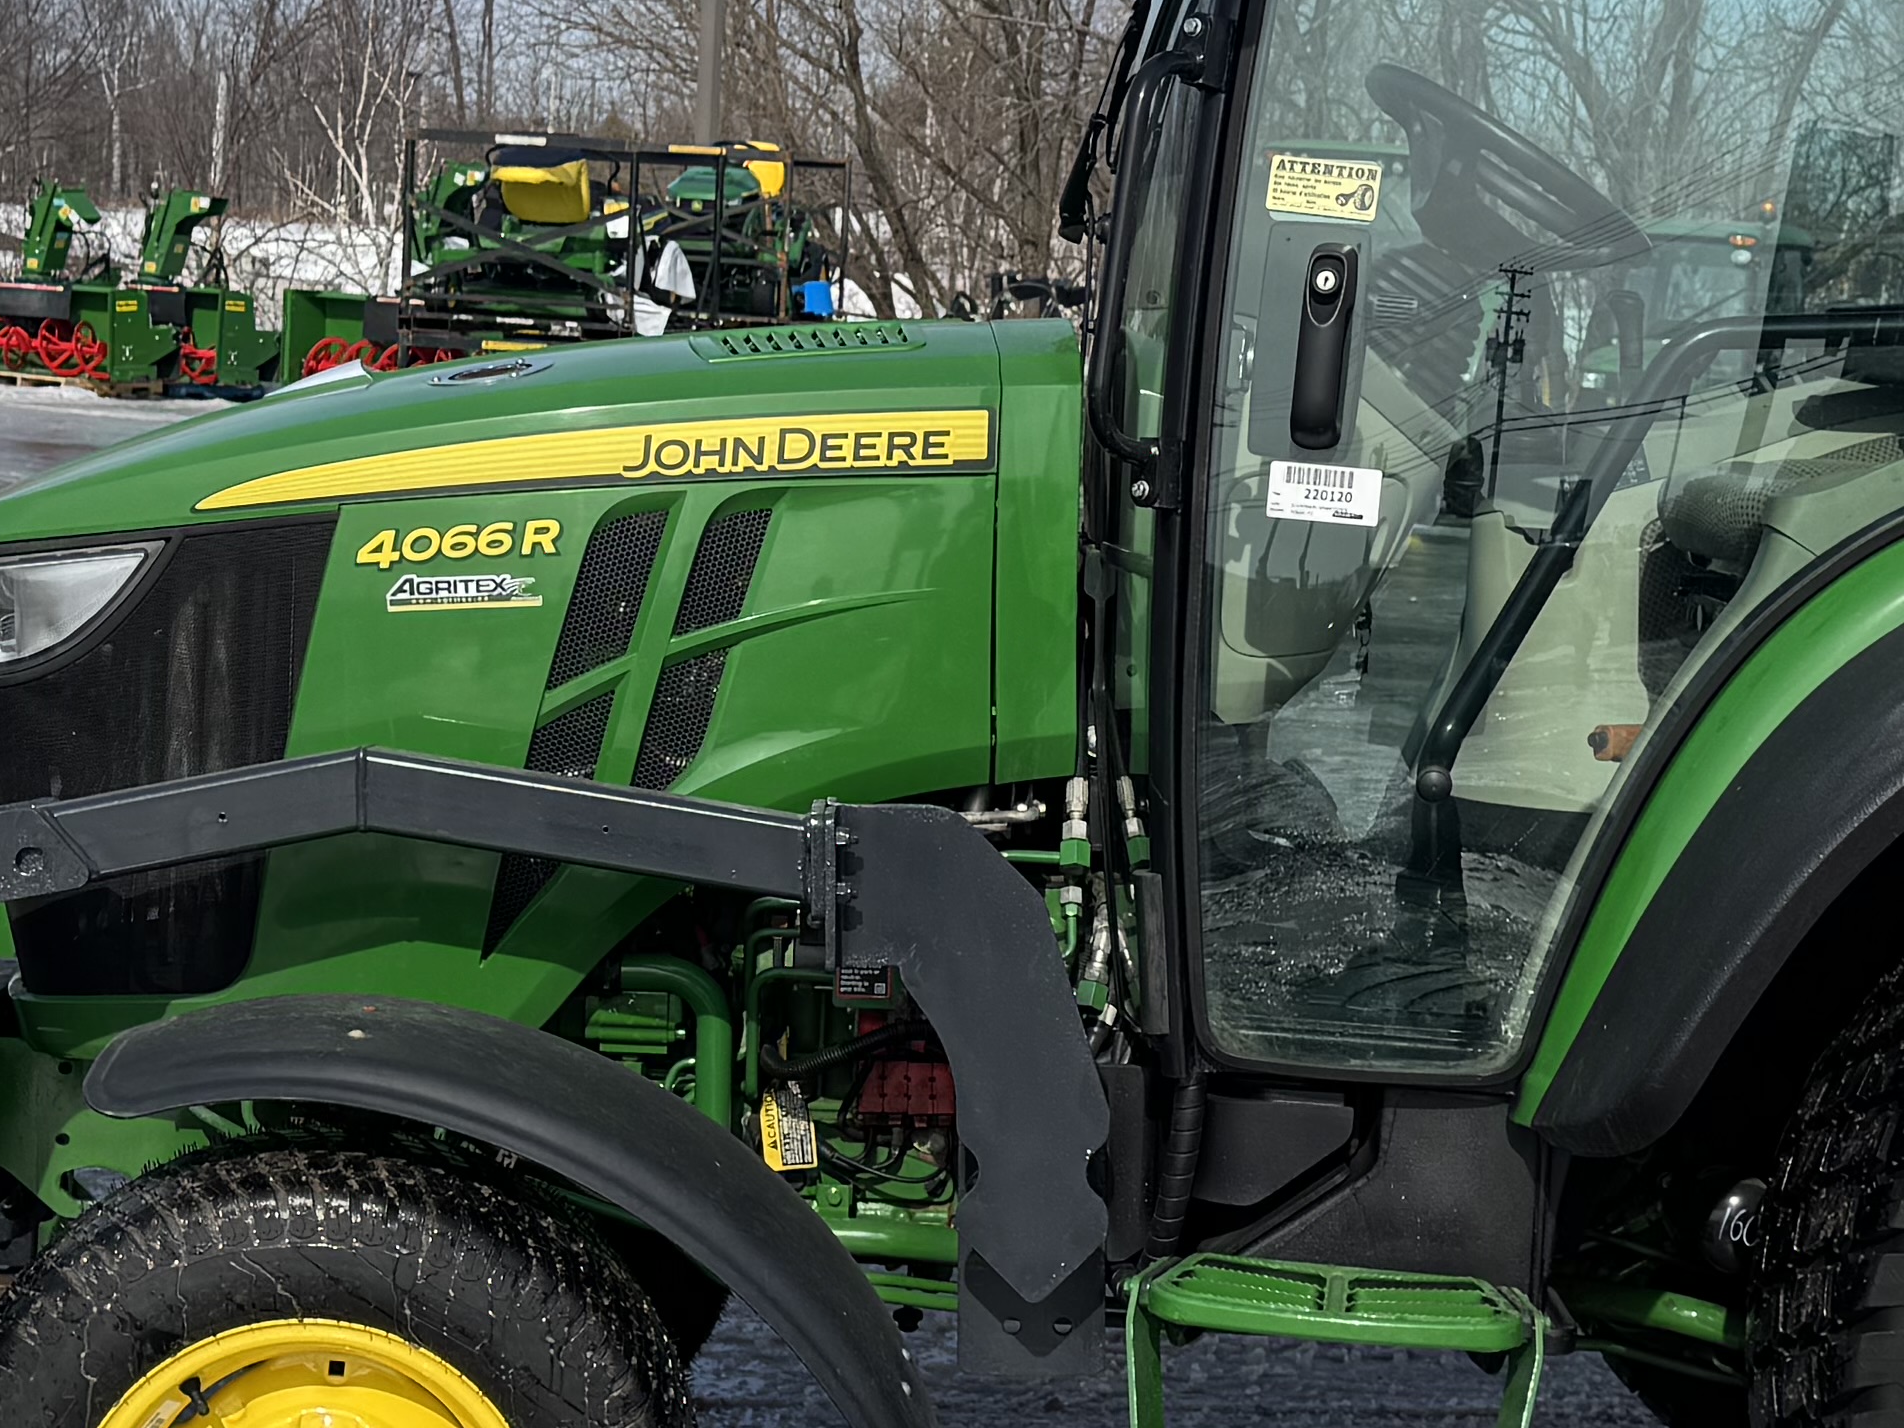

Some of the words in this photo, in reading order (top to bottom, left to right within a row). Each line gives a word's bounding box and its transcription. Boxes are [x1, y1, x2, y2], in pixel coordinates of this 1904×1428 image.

[1276, 158, 1378, 182] ATTENTION
[623, 434, 766, 473] JOHN
[777, 427, 951, 465] DEERE
[1304, 488, 1353, 503] 220120
[390, 577, 508, 598] AGRITEX
